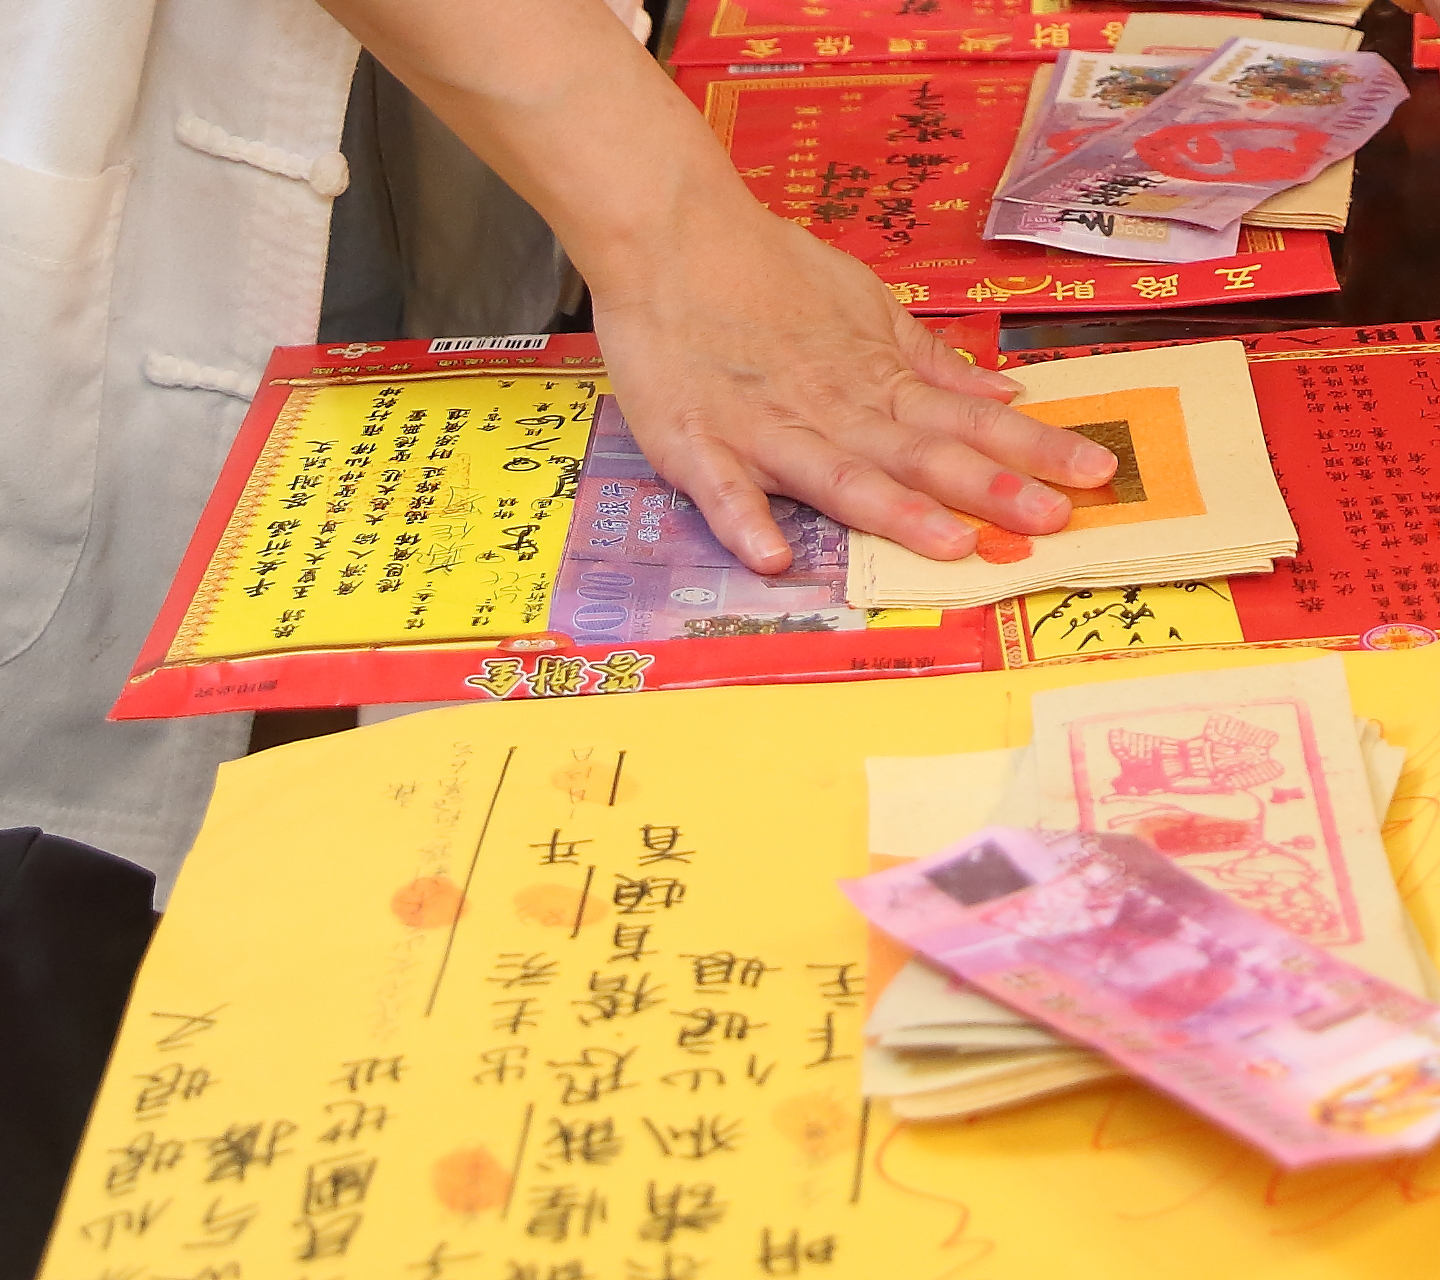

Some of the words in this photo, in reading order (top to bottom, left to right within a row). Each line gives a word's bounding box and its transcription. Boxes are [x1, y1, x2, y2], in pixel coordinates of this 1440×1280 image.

[386, 408, 429, 464] 聖德無量
[424, 407, 472, 462] 財源廣進
[278, 439, 339, 511] 答謝疏文
[362, 468, 407, 528] 大慈大悲
[242, 518, 302, 599] 平安祈福
[465, 649, 656, 698] 答謝金
